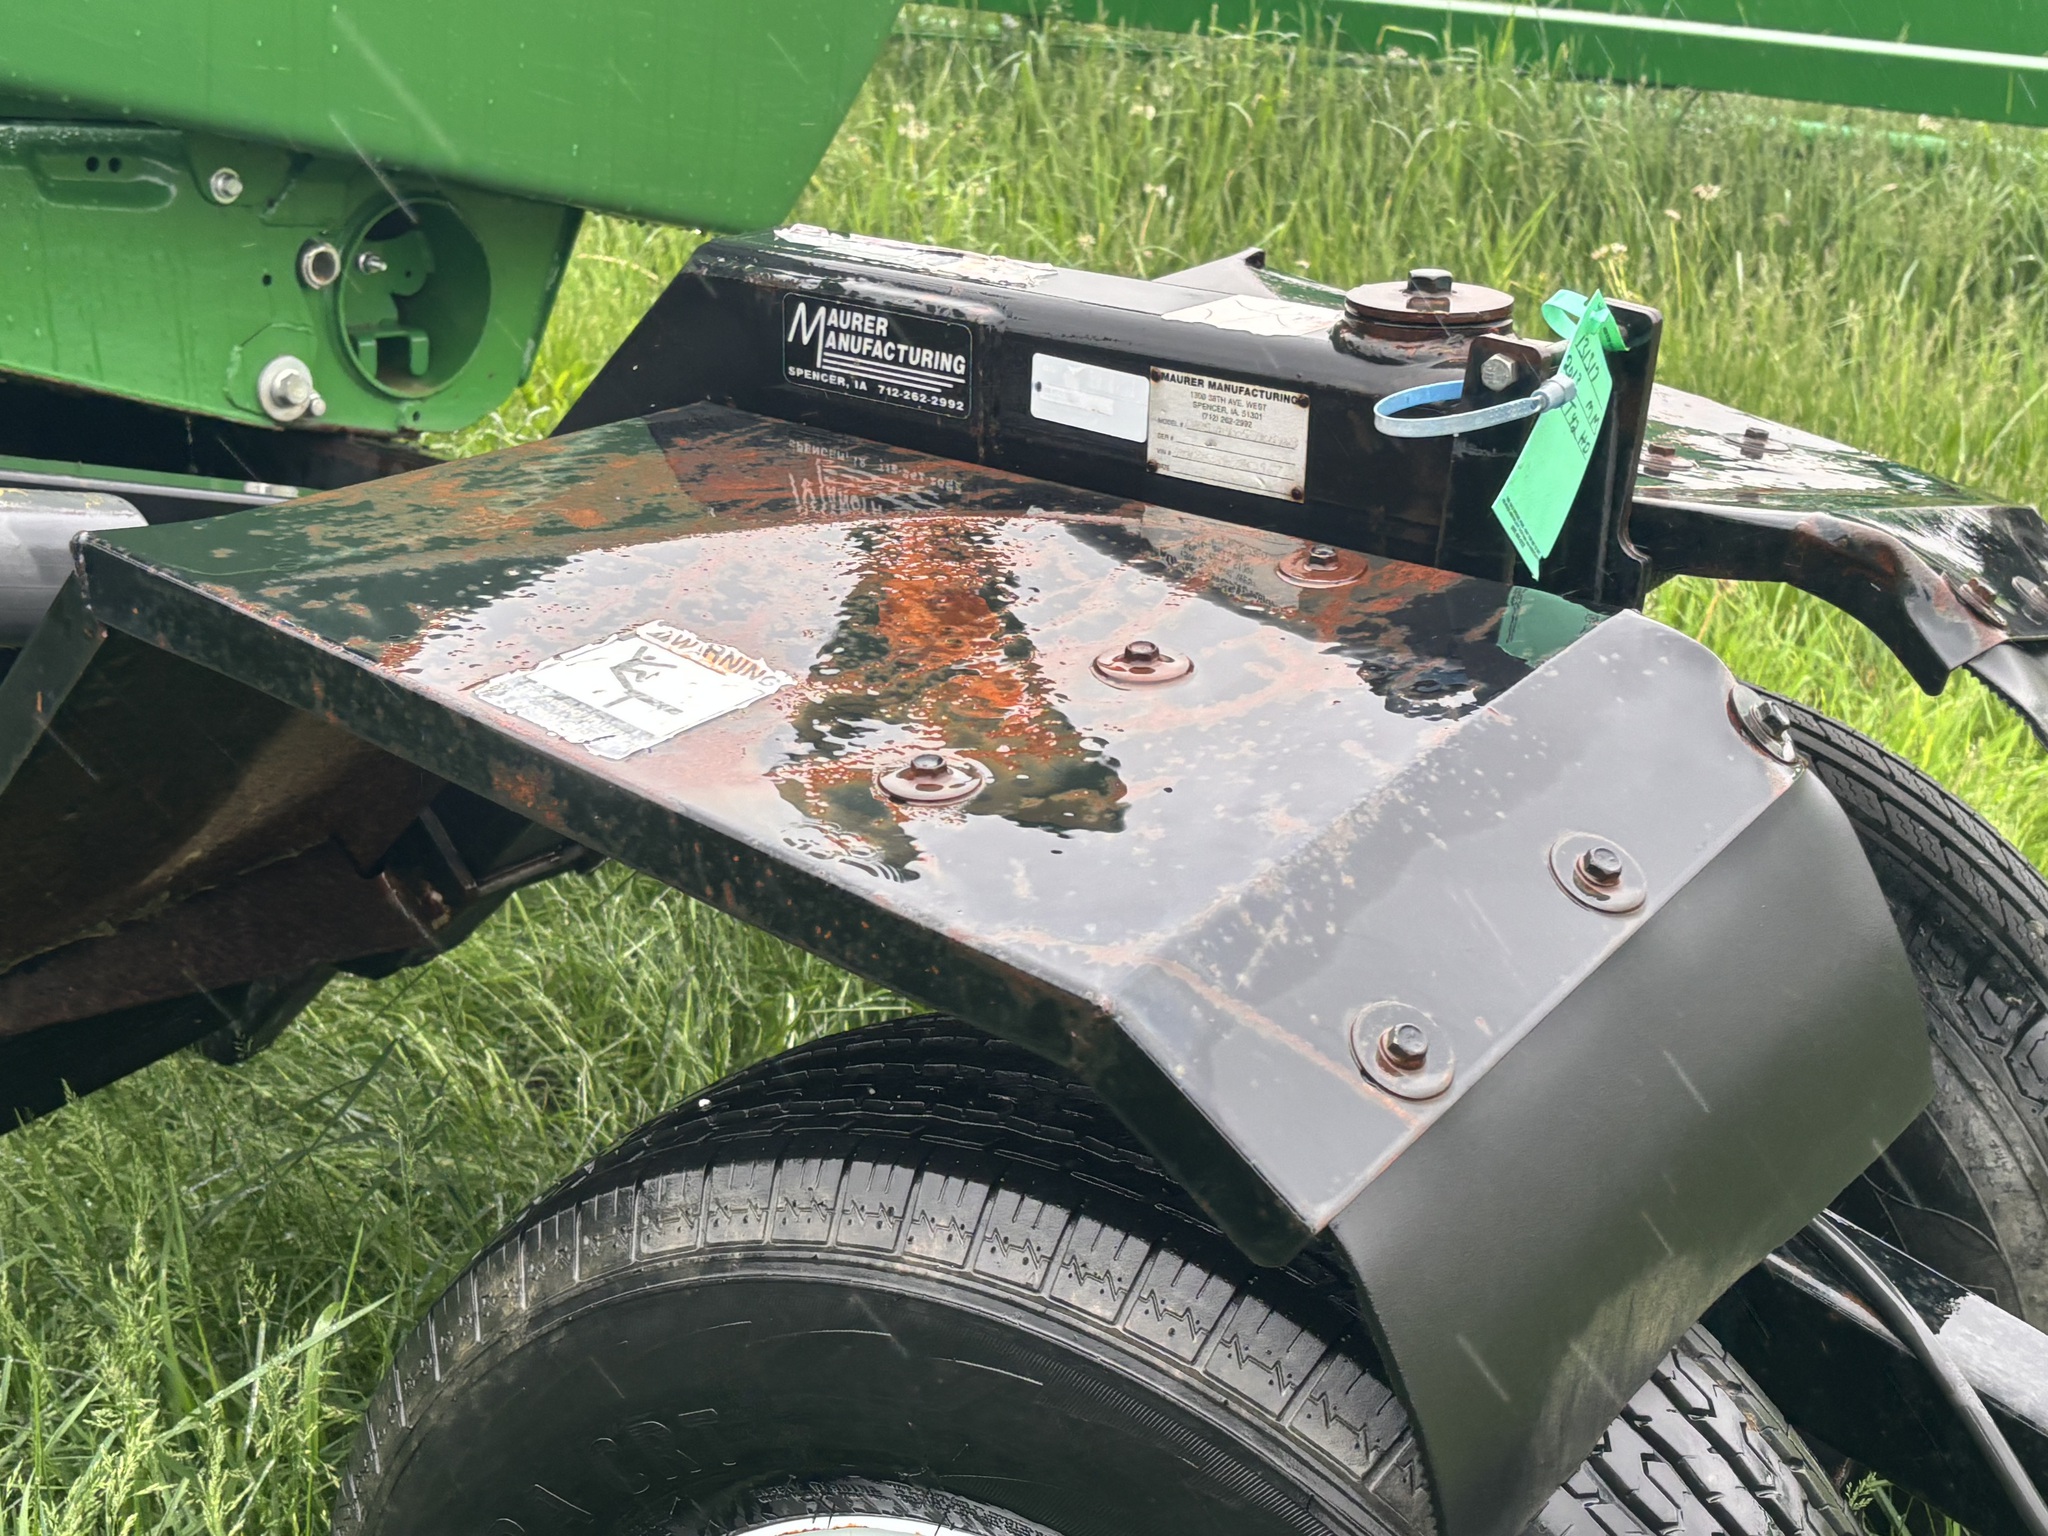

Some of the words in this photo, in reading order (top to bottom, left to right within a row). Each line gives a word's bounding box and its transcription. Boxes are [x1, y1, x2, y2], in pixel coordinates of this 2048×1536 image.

[1161, 372, 1205, 388] MAURER
[788, 366, 850, 389] SPENCER,
[854, 380, 868, 391] IA
[878, 385, 965, 411] 712-262-2992
[1241, 409, 1263, 420] 51301
